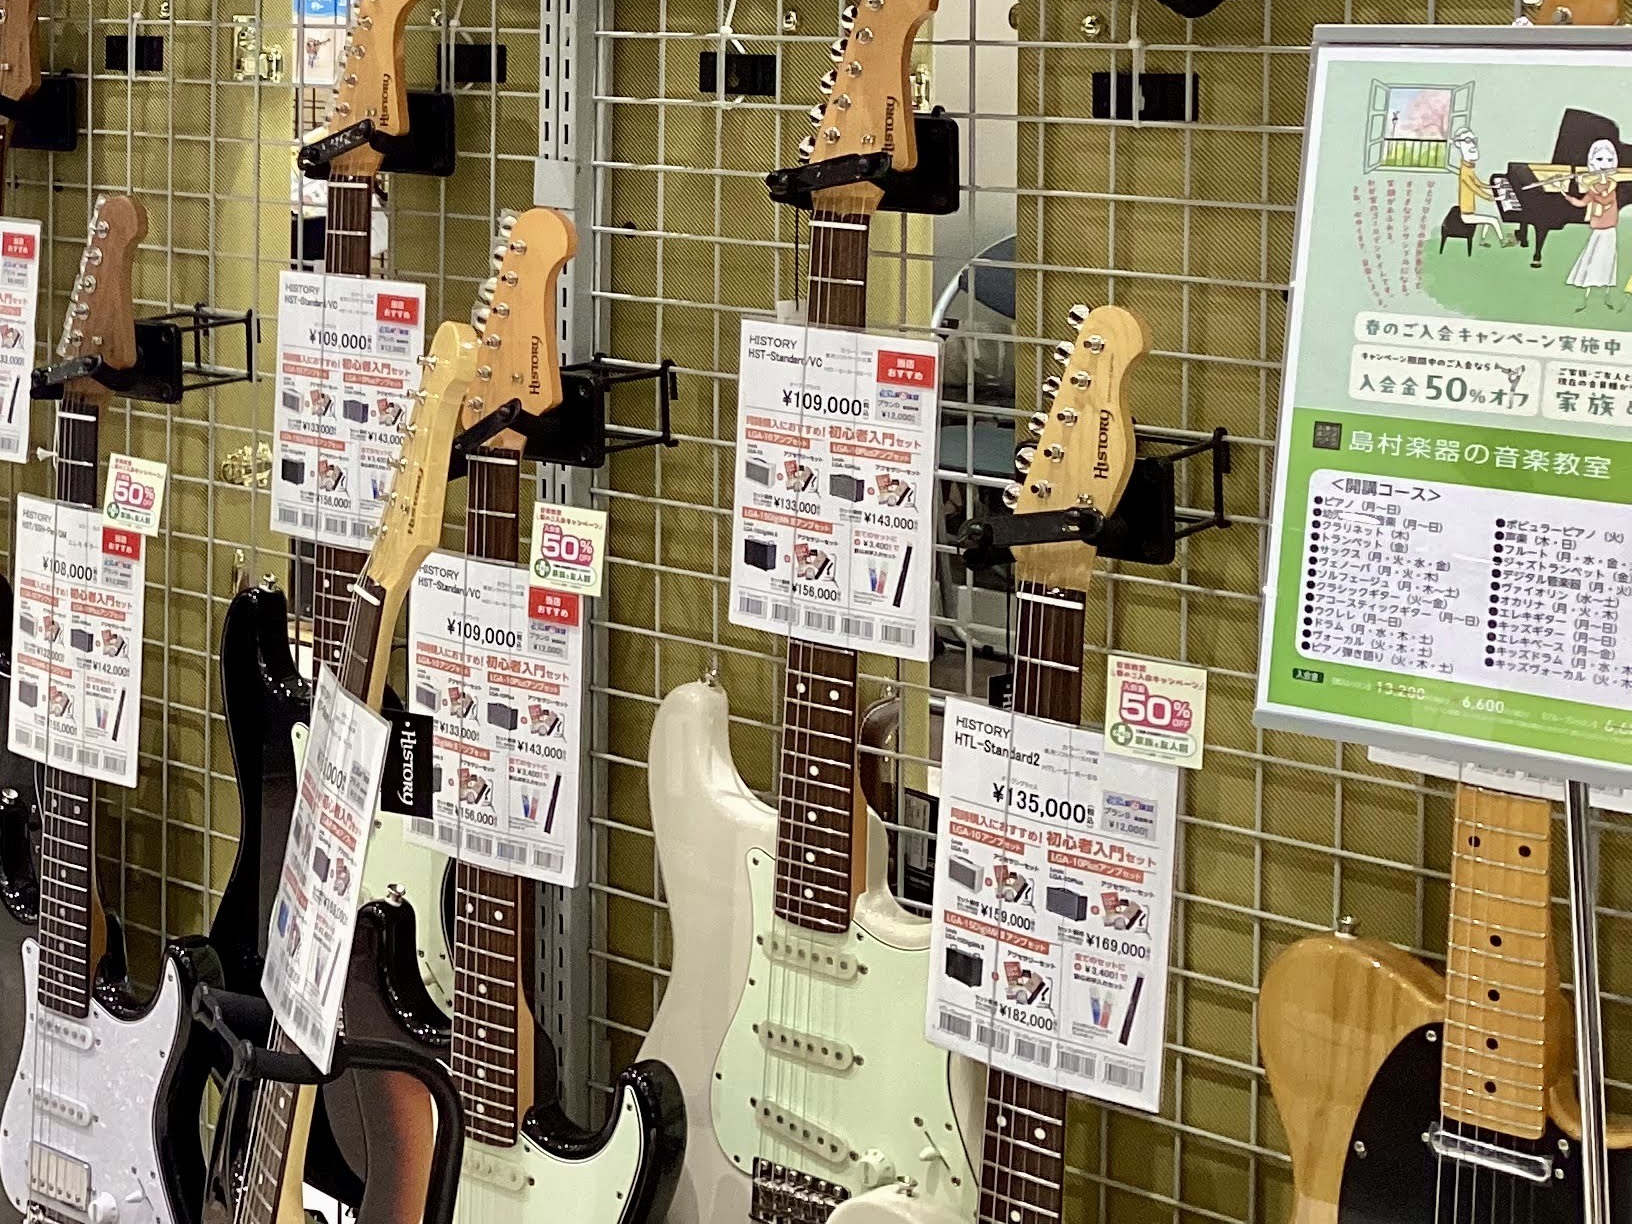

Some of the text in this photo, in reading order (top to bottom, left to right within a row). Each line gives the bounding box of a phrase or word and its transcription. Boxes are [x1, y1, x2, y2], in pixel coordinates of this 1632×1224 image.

[309, 329, 367, 350] ¥109,000
[750, 335, 797, 349] HISTORY
[1365, 318, 1622, 357] 春のご入会キャンペーン実施中
[529, 336, 543, 395] HISTORY
[783, 389, 862, 417] ¥109,000
[1556, 390, 1632, 417] 家族
[829, 425, 921, 449] 初心者入門セット
[1093, 409, 1114, 479] HISTORY
[1348, 430, 1612, 480] 島村楽器の音楽教室
[774, 498, 816, 514] ¥133,000
[864, 512, 914, 529] ¥143,000
[542, 532, 593, 560] 50%
[43, 556, 92, 581] ¥108,000
[447, 618, 516, 647] ¥109,000
[486, 655, 569, 682] 初心者入門セット
[1120, 692, 1191, 726] 50%
[956, 716, 1011, 740] HISTORY
[518, 741, 562, 760] ¥143,000
[955, 731, 1040, 767] HTL-Standard2
[992, 782, 1086, 824] ¥135,000
[1046, 831, 1157, 868] 初心者入門セット
[981, 905, 1031, 930] ¥159,000
[1086, 934, 1145, 959] ¥169,000
[1000, 1005, 1053, 1031] ¥182,000
